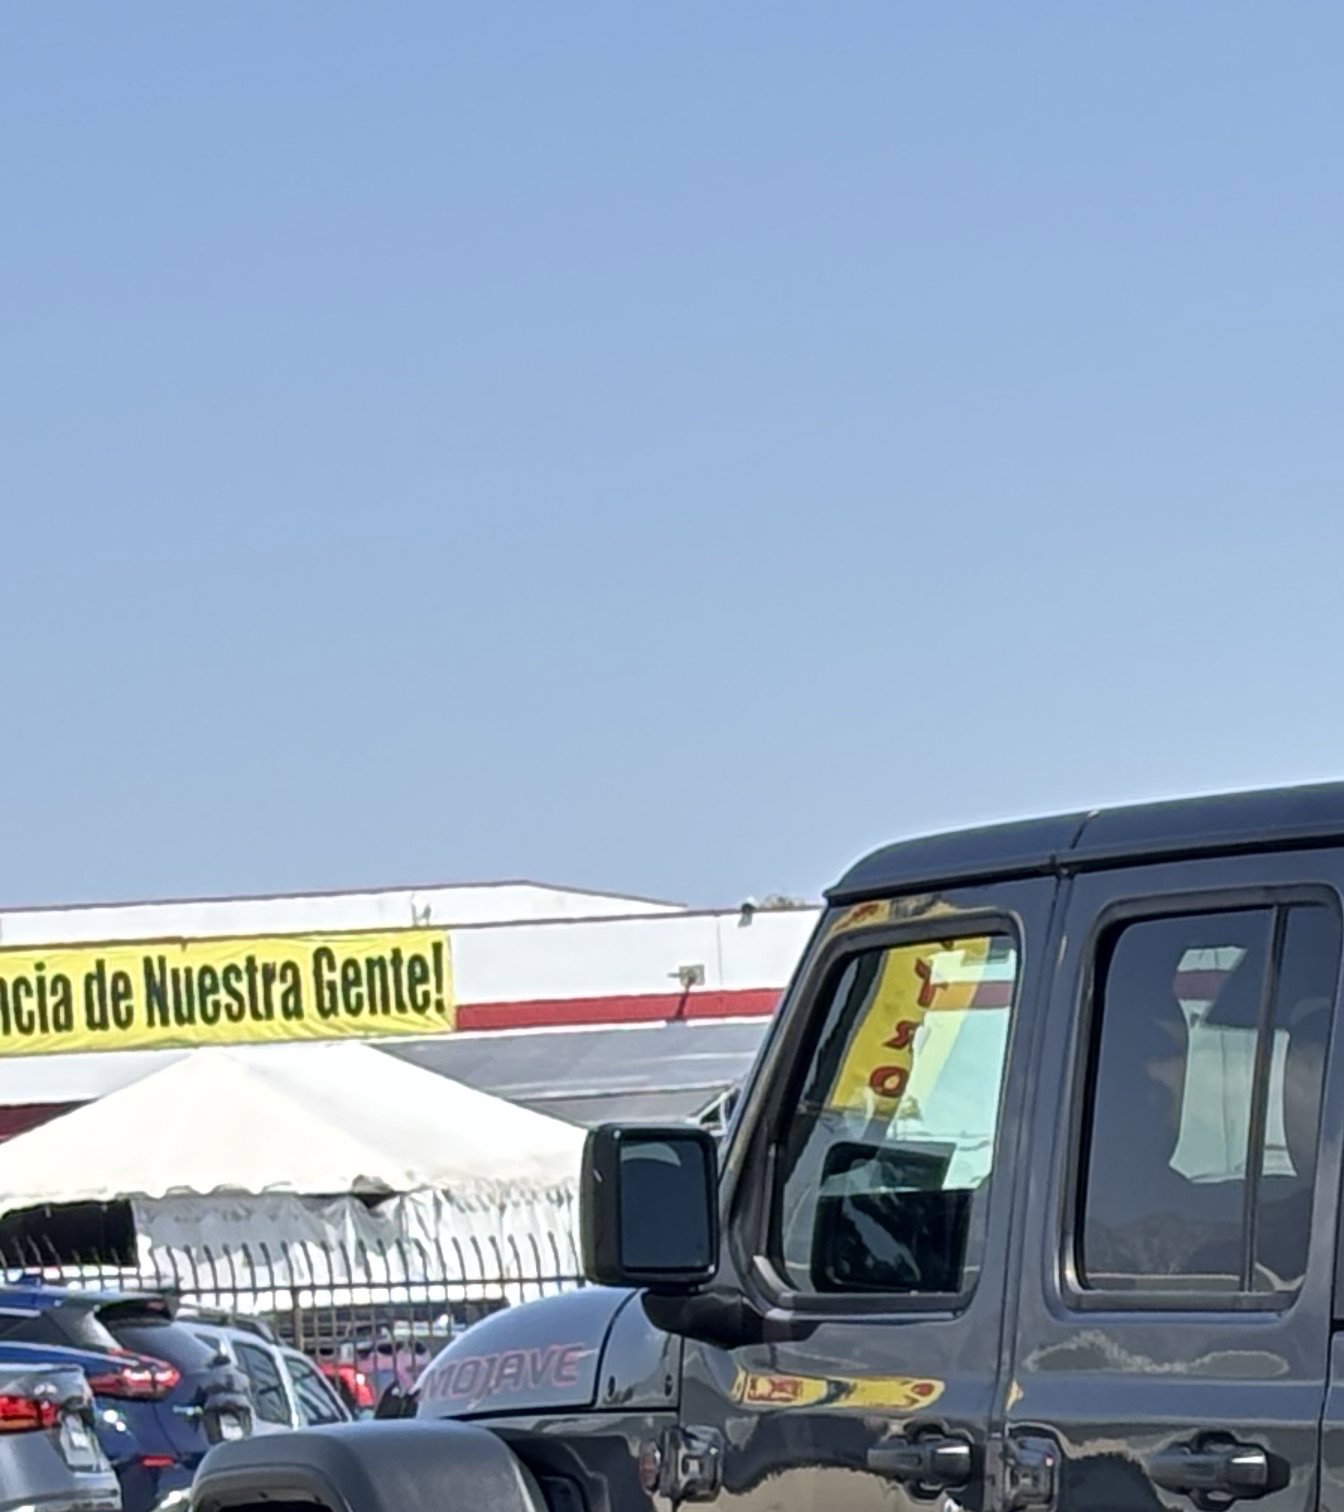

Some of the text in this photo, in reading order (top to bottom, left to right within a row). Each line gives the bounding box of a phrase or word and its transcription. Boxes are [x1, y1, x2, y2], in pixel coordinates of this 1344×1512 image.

[84, 958, 134, 1031] de
[143, 954, 304, 1028] Nuestra
[312, 941, 445, 1020] Gente!
[423, 1343, 585, 1401] MOJAVE
